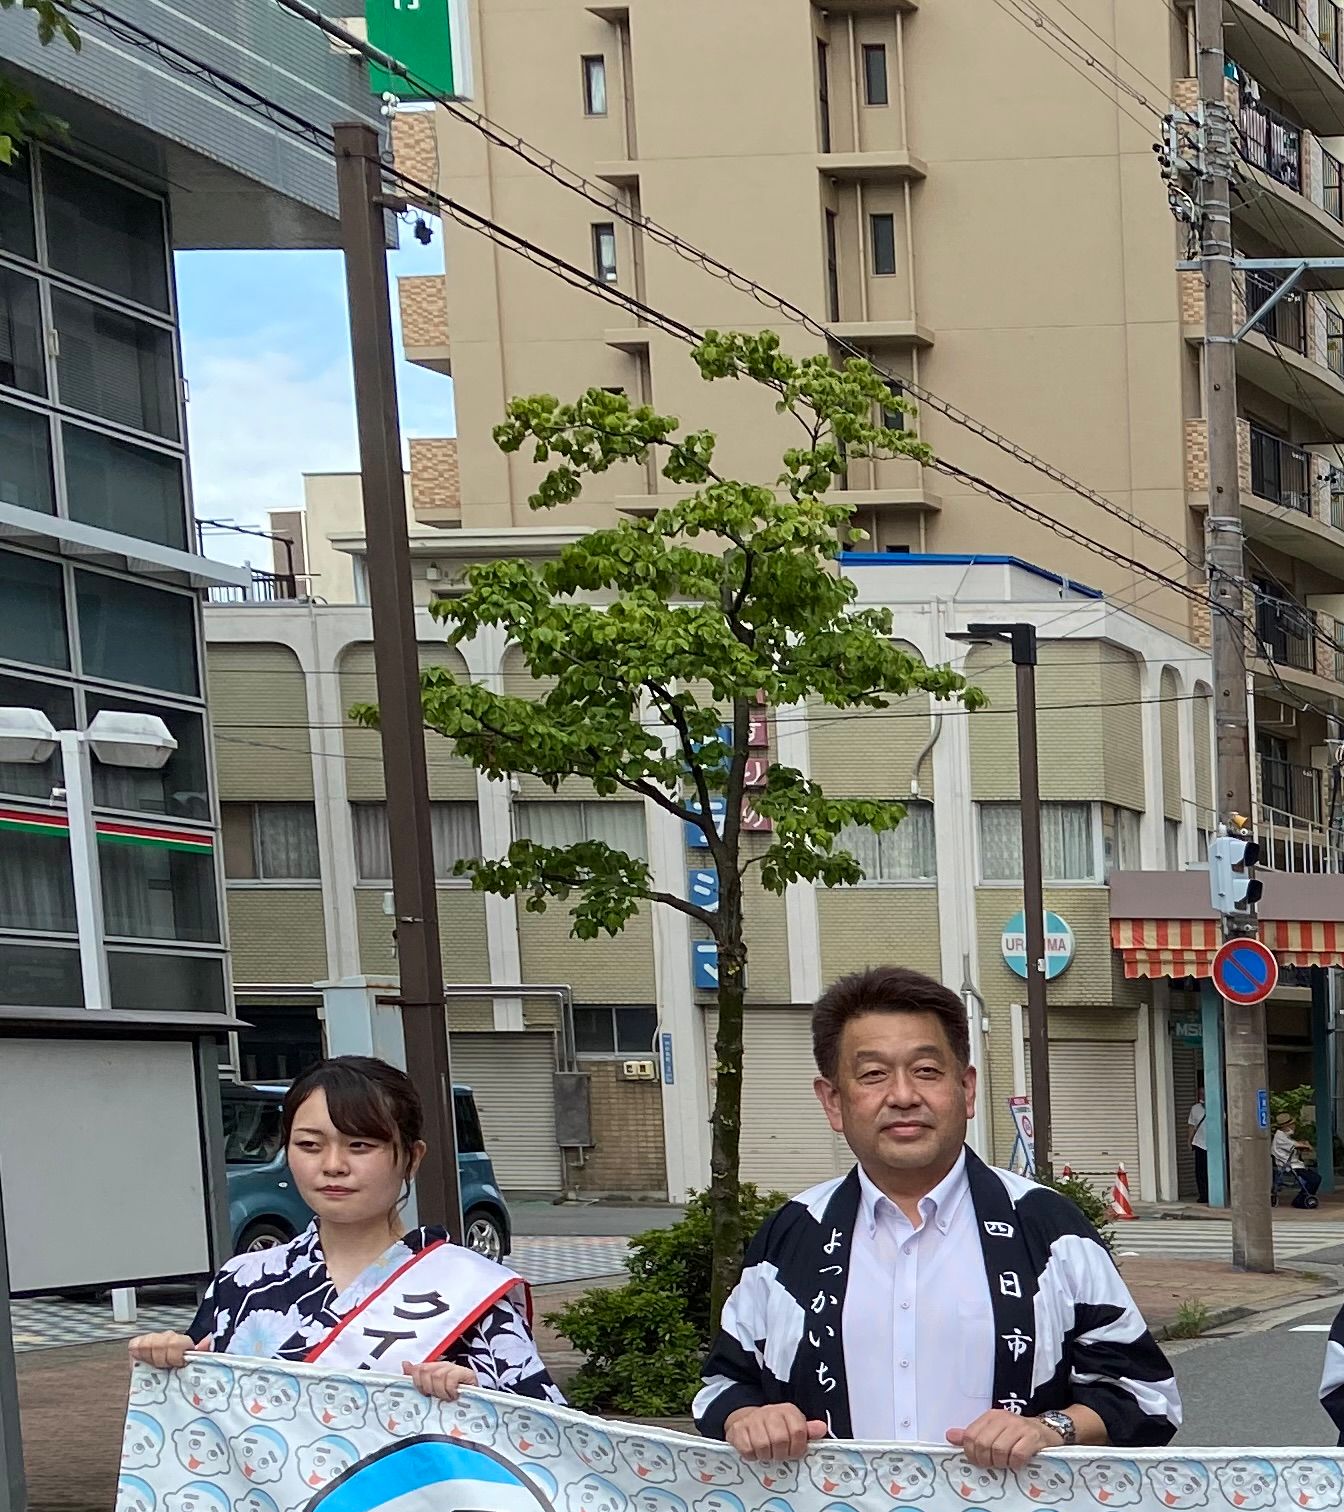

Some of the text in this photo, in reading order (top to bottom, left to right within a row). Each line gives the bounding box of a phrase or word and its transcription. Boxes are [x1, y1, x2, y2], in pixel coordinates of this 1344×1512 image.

[1005, 938, 1067, 952] URMA
[1175, 1023, 1202, 1036] MS
[358, 1290, 450, 1371] クイ
[808, 1228, 844, 1439] よっかいちし
[984, 1220, 1033, 1415] 四日市市
